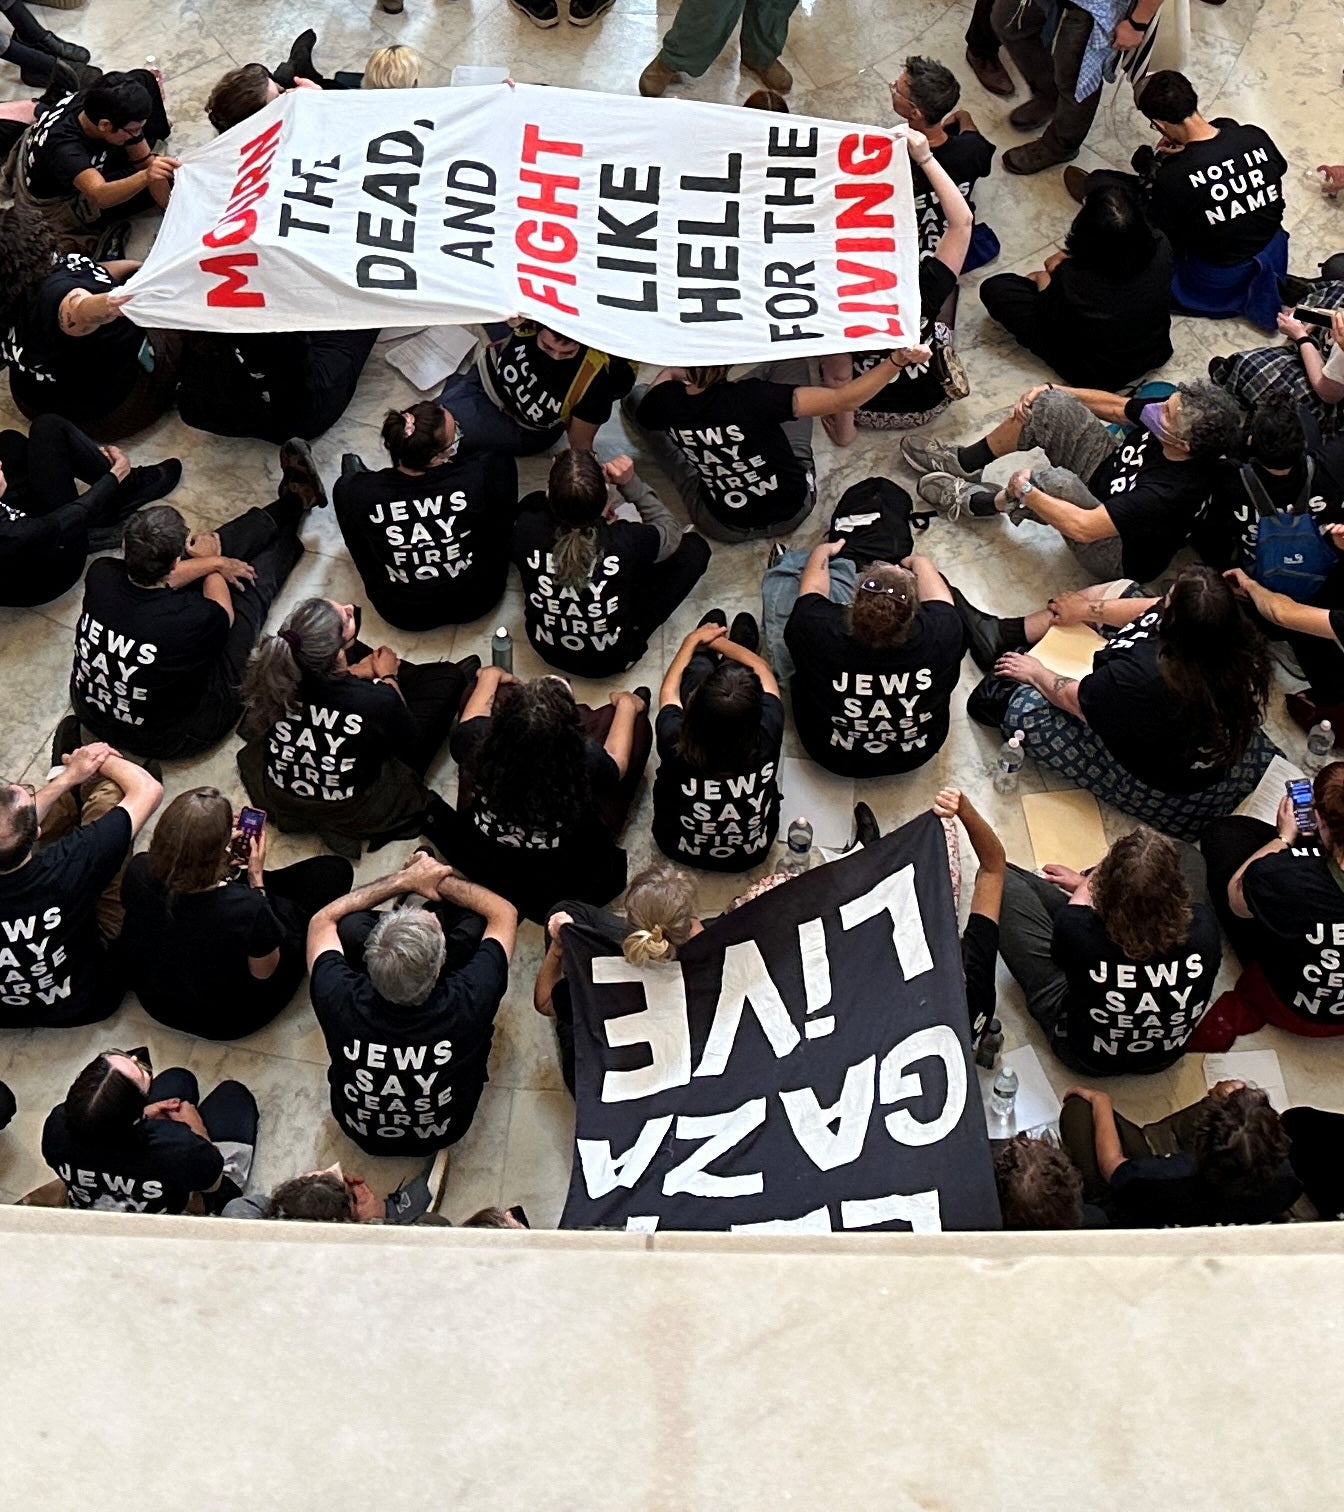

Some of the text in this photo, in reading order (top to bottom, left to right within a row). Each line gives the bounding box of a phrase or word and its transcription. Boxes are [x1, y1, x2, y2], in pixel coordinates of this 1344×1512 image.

[1188, 147, 1270, 190] NOT IN
[1209, 169, 1266, 202] OUR
[279, 154, 341, 238] THE
[355, 118, 437, 291] DEAD,
[1204, 184, 1281, 226] NAME
[440, 159, 498, 269] AND
[515, 124, 584, 317] FIGHT
[596, 164, 661, 313] LIKE
[676, 152, 744, 323] HELL
[764, 126, 825, 343] FOR THE
[831, 133, 905, 339] LIVING
[537, 390, 561, 415] IN
[685, 444, 742, 469] SAY
[369, 490, 469, 525] JEWS
[387, 515, 455, 547] SAY
[393, 544, 461, 567] FIRE
[529, 591, 620, 618] CEASE
[539, 576, 607, 603] SAY
[80, 612, 158, 664] JEWS
[534, 625, 622, 653] NOW
[544, 614, 608, 633] FIRE
[79, 637, 139, 683] SAY
[832, 668, 933, 695] JEWS
[843, 698, 916, 720] SAY
[276, 720, 348, 754] SAY
[679, 760, 775, 802] JEWS
[691, 789, 768, 824] SAY
[1088, 953, 1204, 990] JEWS
[1105, 985, 1194, 1015] SAY
[343, 1039, 453, 1073] JEWS
[1092, 1022, 1200, 1057] NOW
[343, 1080, 453, 1113] CEASE
[354, 1068, 441, 1098] SAY
[345, 1114, 453, 1139] NOW
[356, 1106, 437, 1125] FIRE
[577, 1024, 968, 1200] GAZA
[57, 1162, 164, 1200] JEWS
